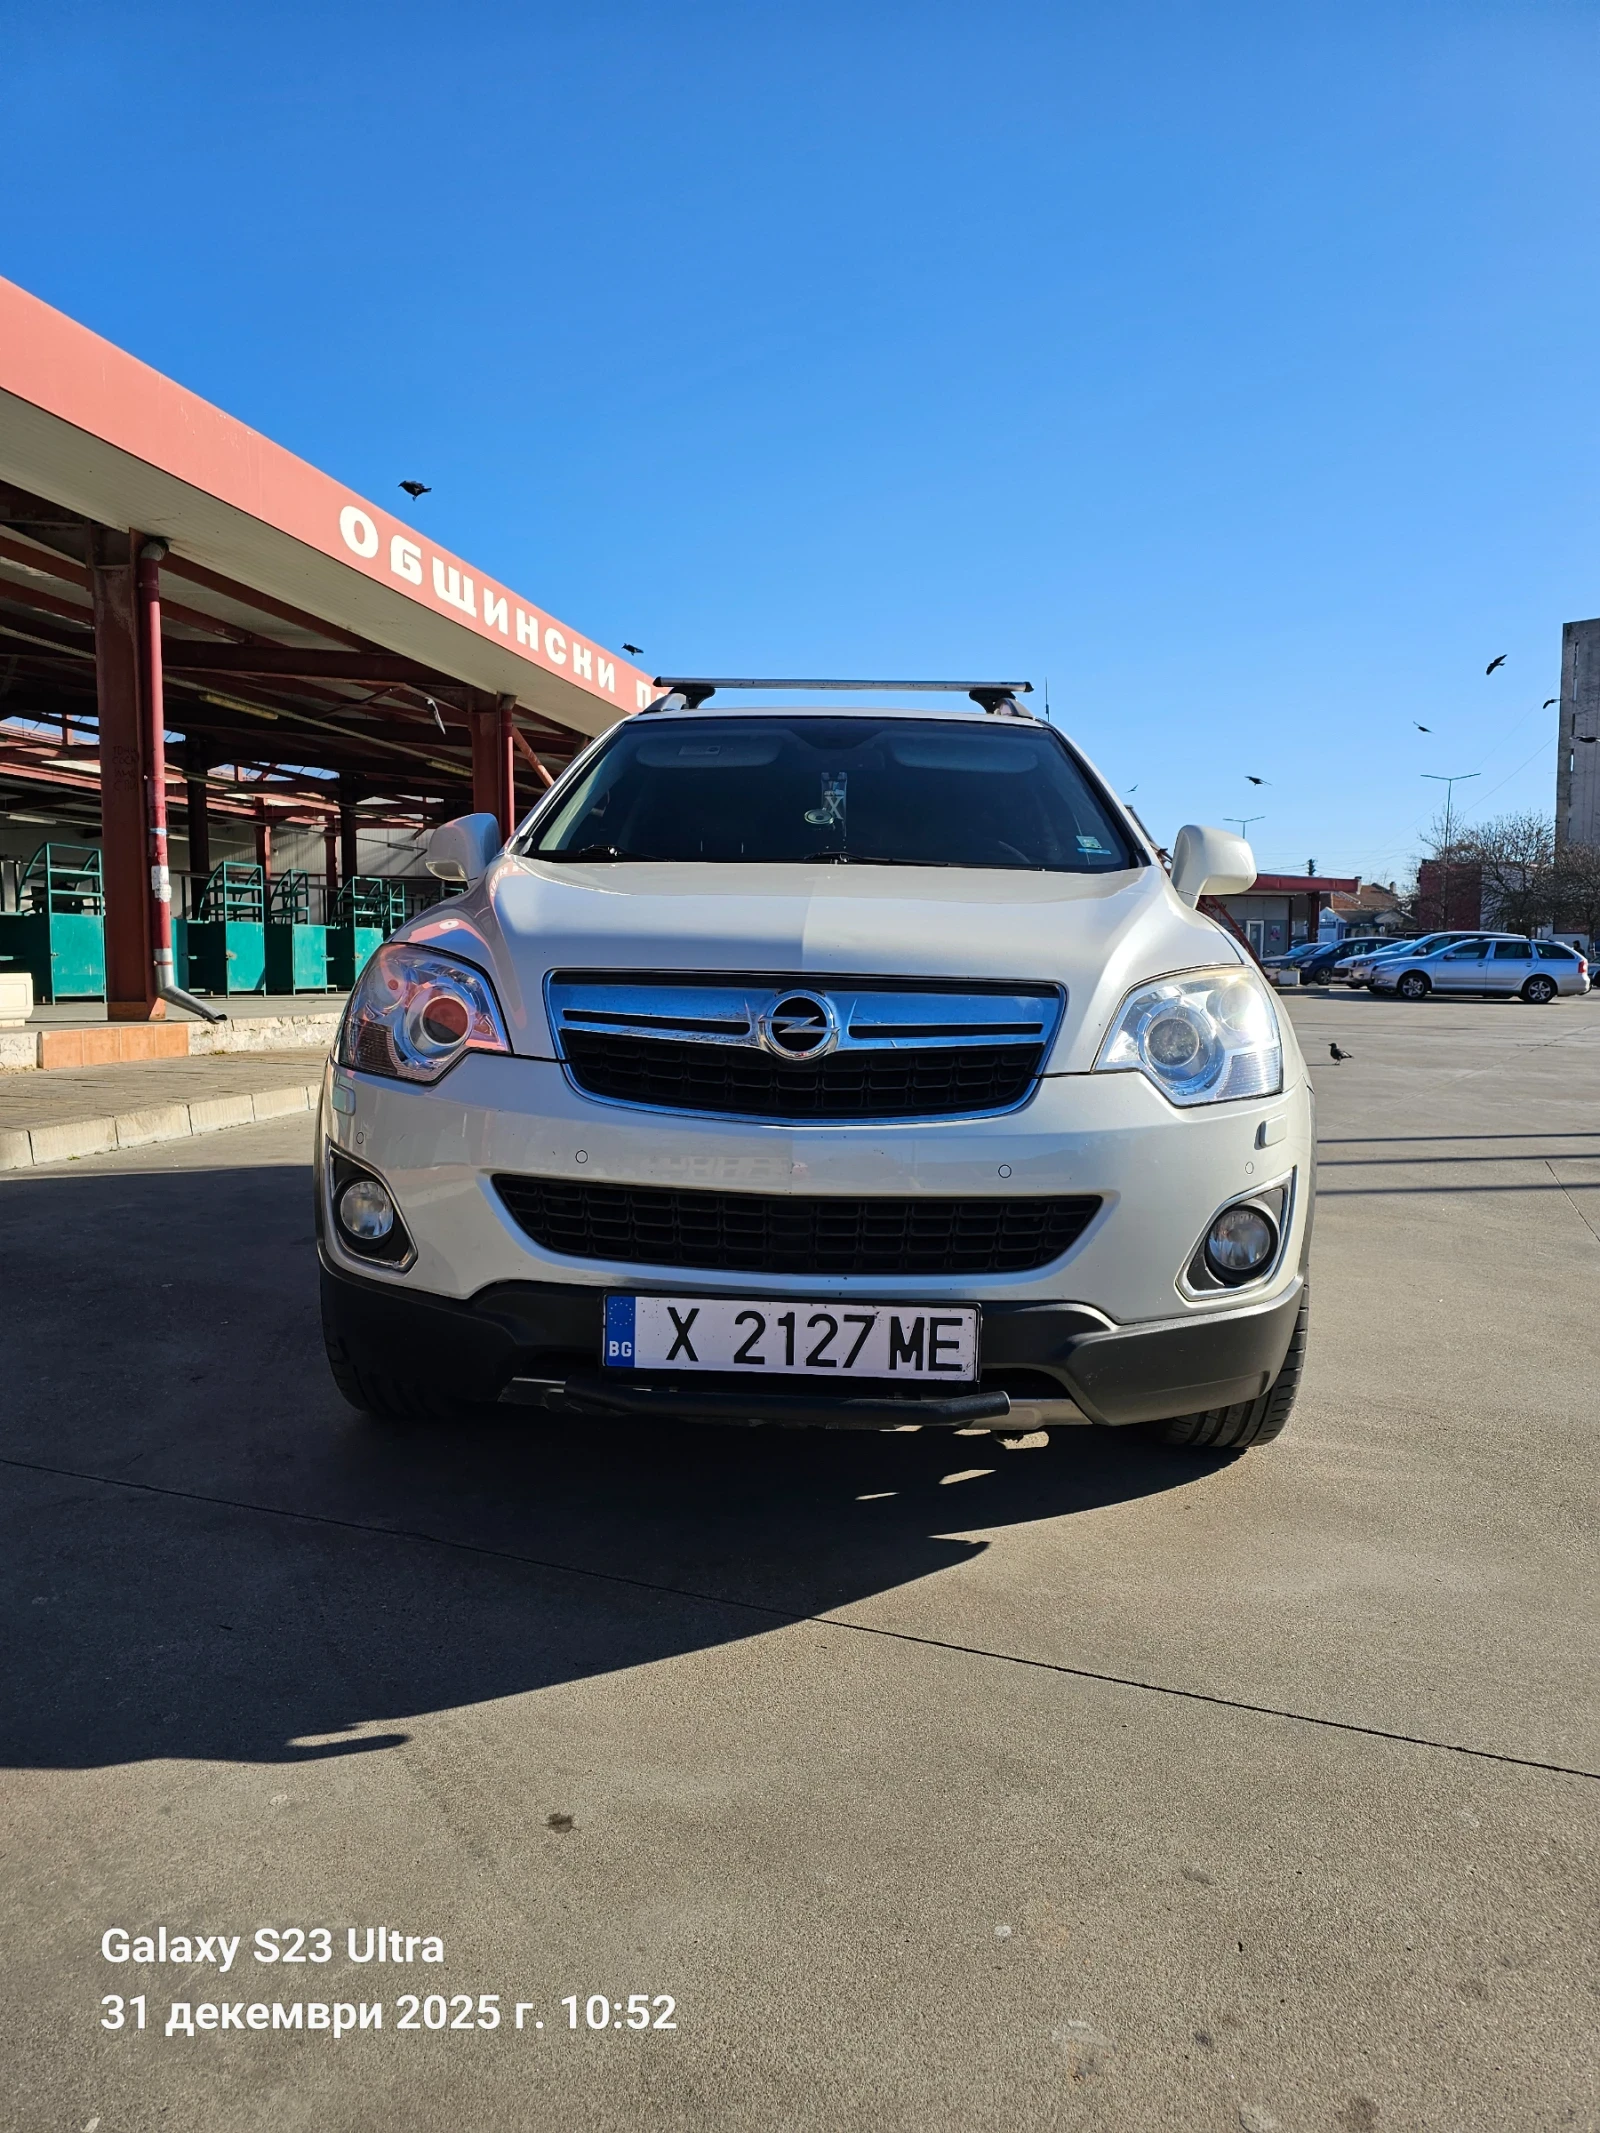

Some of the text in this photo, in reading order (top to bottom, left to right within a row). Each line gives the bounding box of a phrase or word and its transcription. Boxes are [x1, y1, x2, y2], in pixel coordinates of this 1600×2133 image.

[339, 505, 668, 710] ОБЩИНСКИ П
[609, 1341, 632, 1358] BG
[666, 1307, 964, 1371] X 2127 ME
